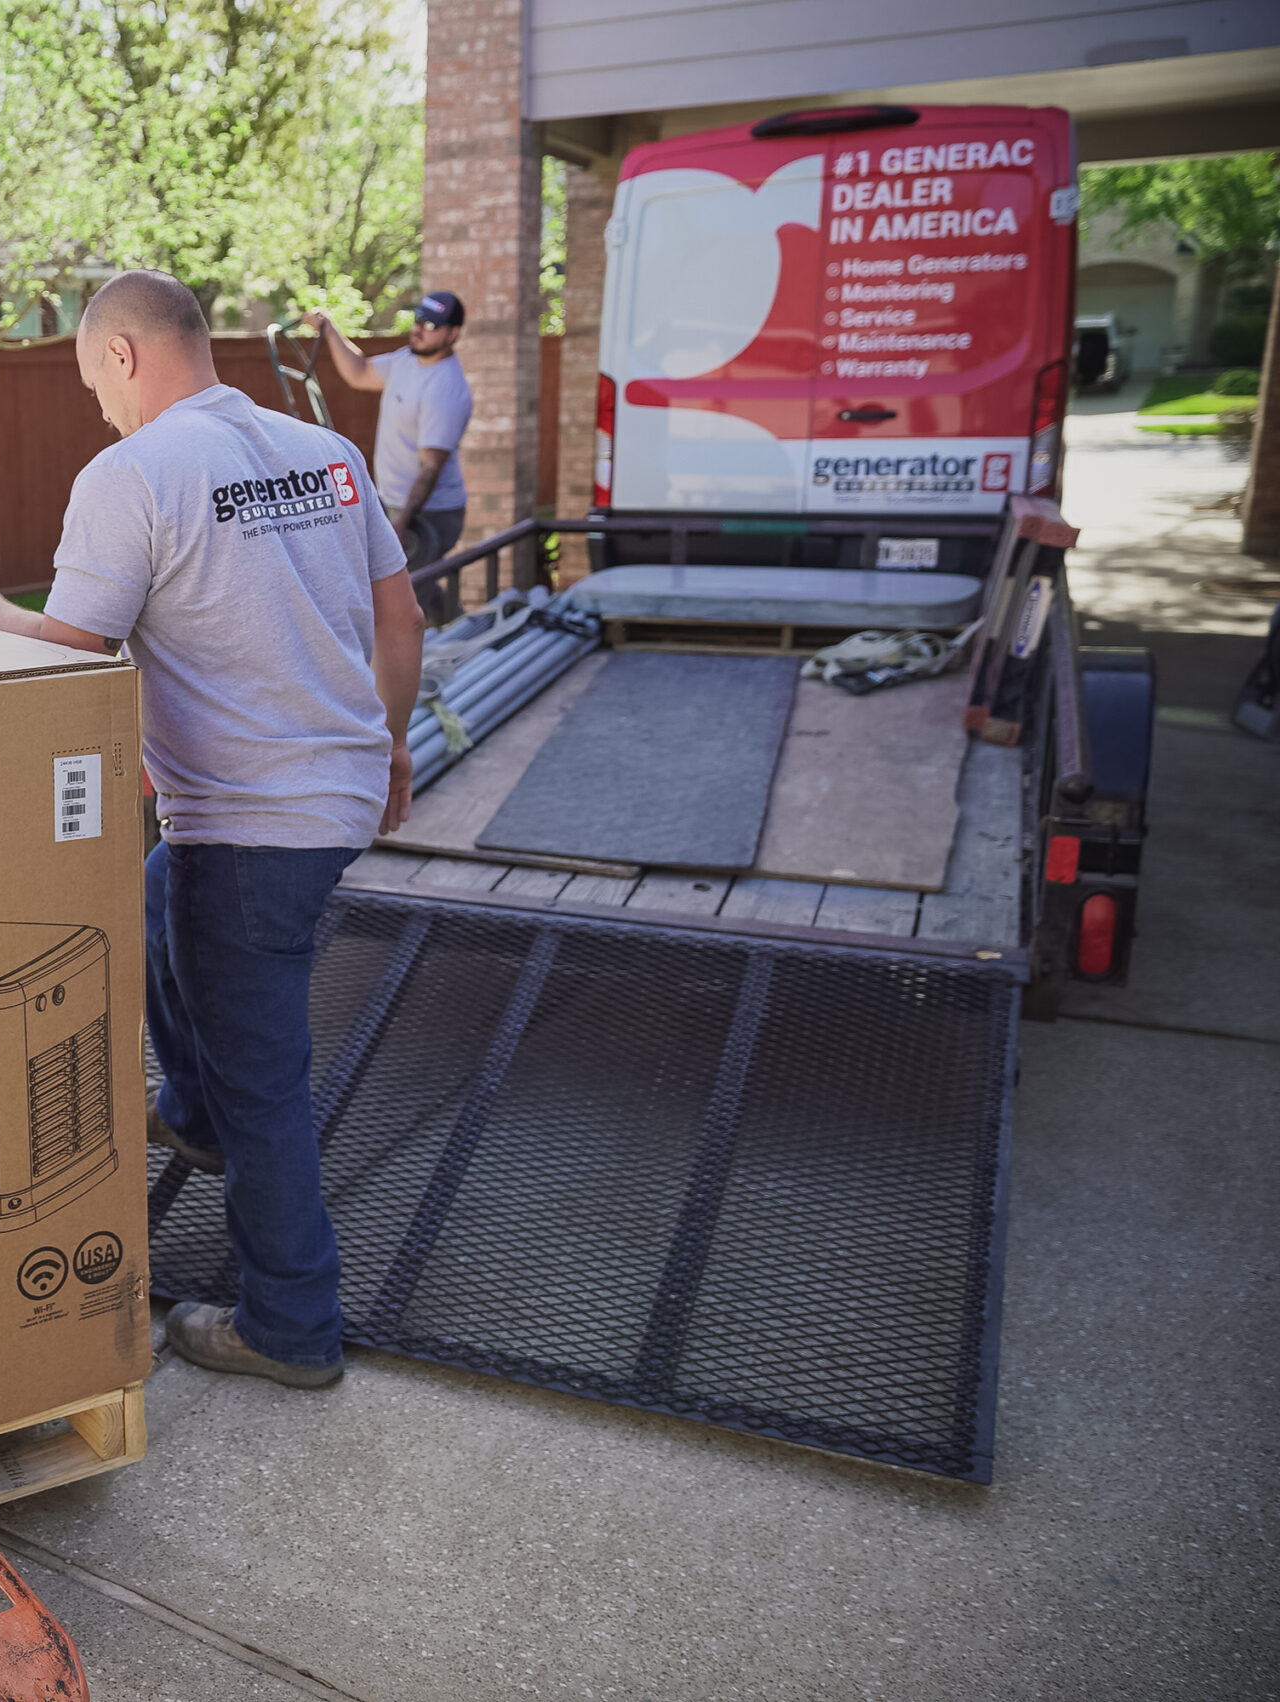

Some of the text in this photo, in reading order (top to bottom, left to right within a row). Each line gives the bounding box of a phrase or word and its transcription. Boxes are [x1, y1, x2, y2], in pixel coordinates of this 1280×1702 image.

[833, 138, 1035, 178] #1 GENERAC
[831, 176, 953, 212] DEALER
[829, 207, 1018, 244] IN AMERICA
[842, 253, 1028, 278] Home Generators
[841, 278, 955, 303] Monitoring
[839, 305, 916, 328] Service
[838, 331, 972, 353] Maintenance
[836, 358, 929, 380] Warranty
[813, 452, 977, 486] generator
[242, 527, 262, 540] THE
[81, 1244, 115, 1267] USA
